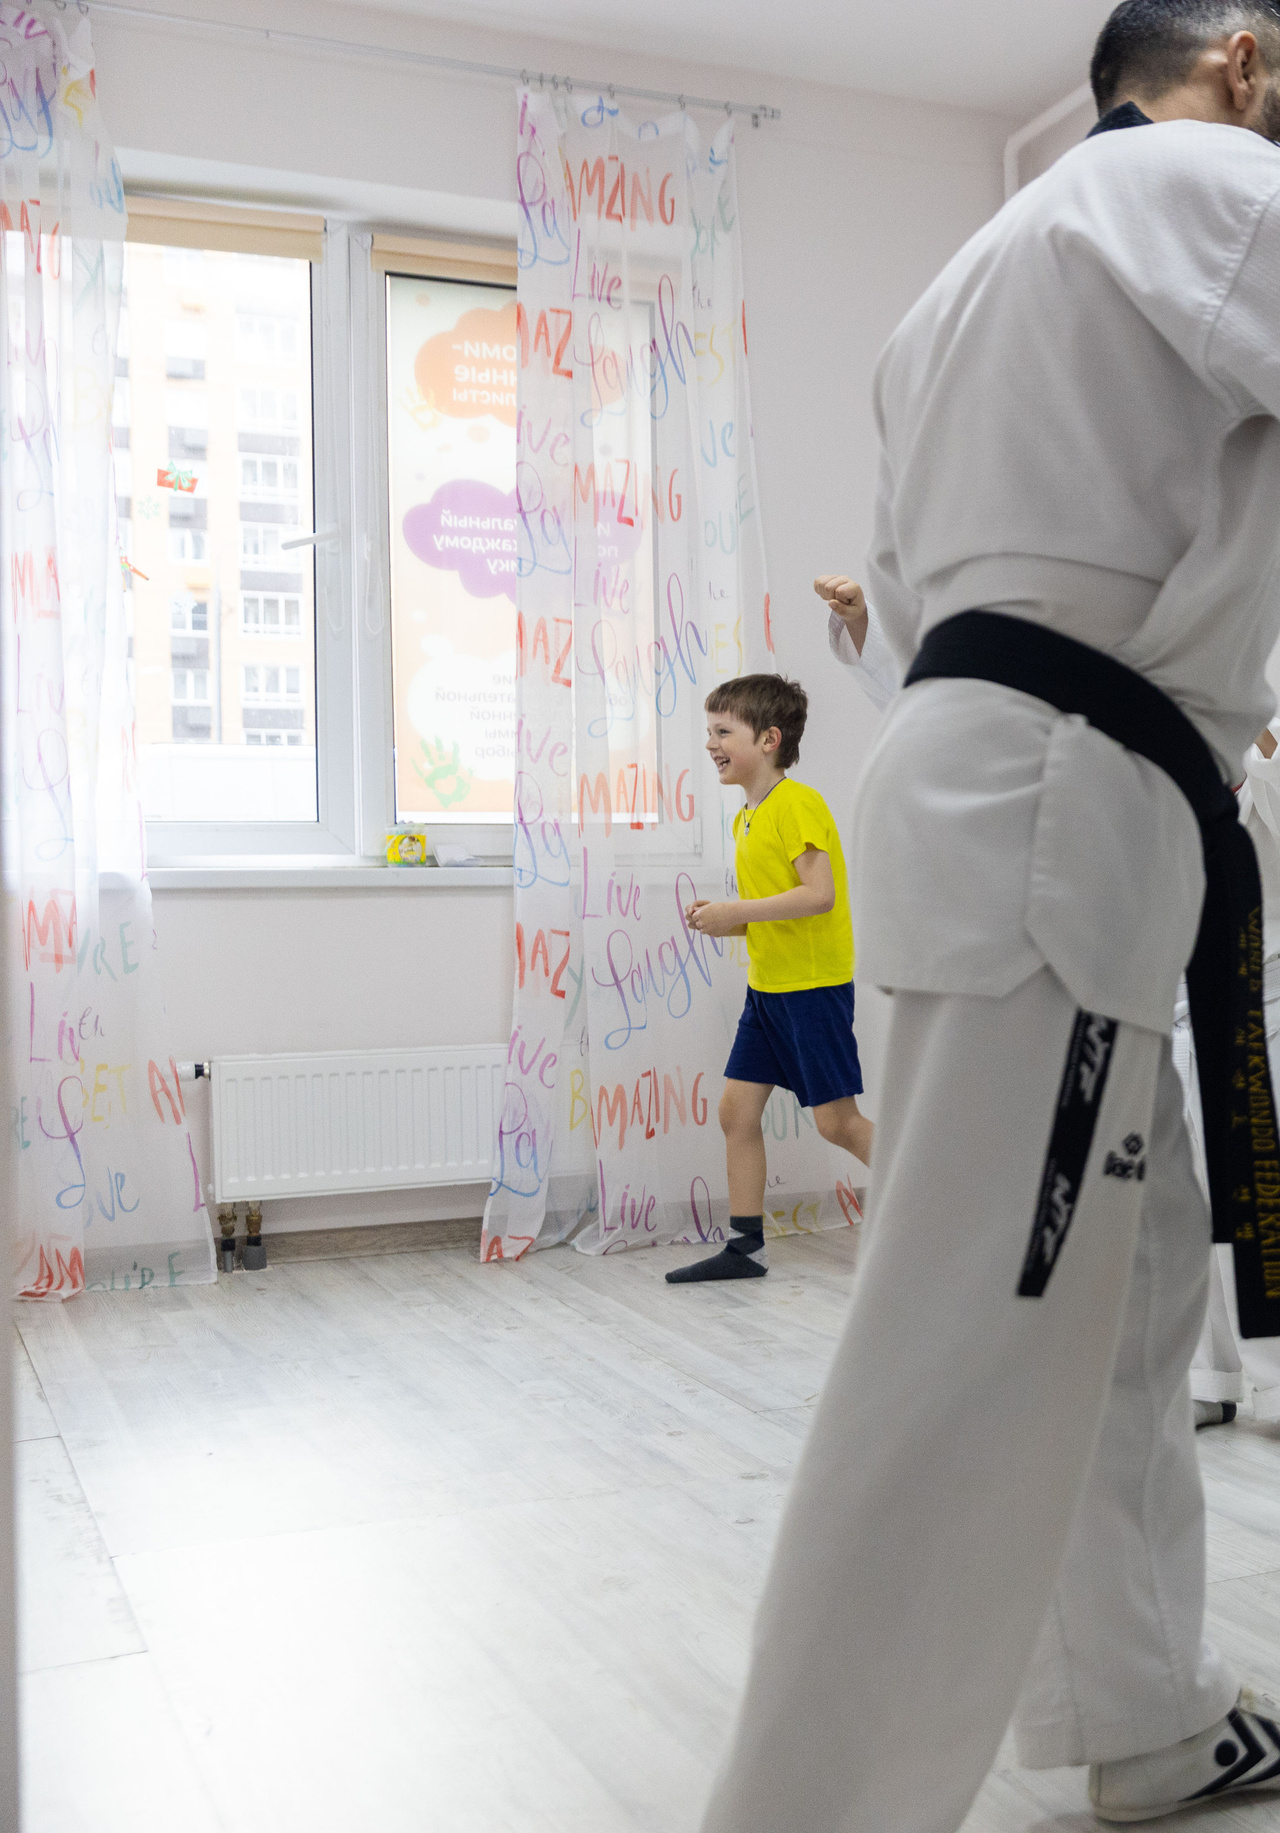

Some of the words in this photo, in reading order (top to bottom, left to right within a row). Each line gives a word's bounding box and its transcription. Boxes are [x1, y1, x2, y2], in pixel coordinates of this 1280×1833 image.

[574, 458, 682, 532] MAZING
[578, 763, 695, 838] MAZING
[1247, 1009, 1277, 1152] TAEKWONDO
